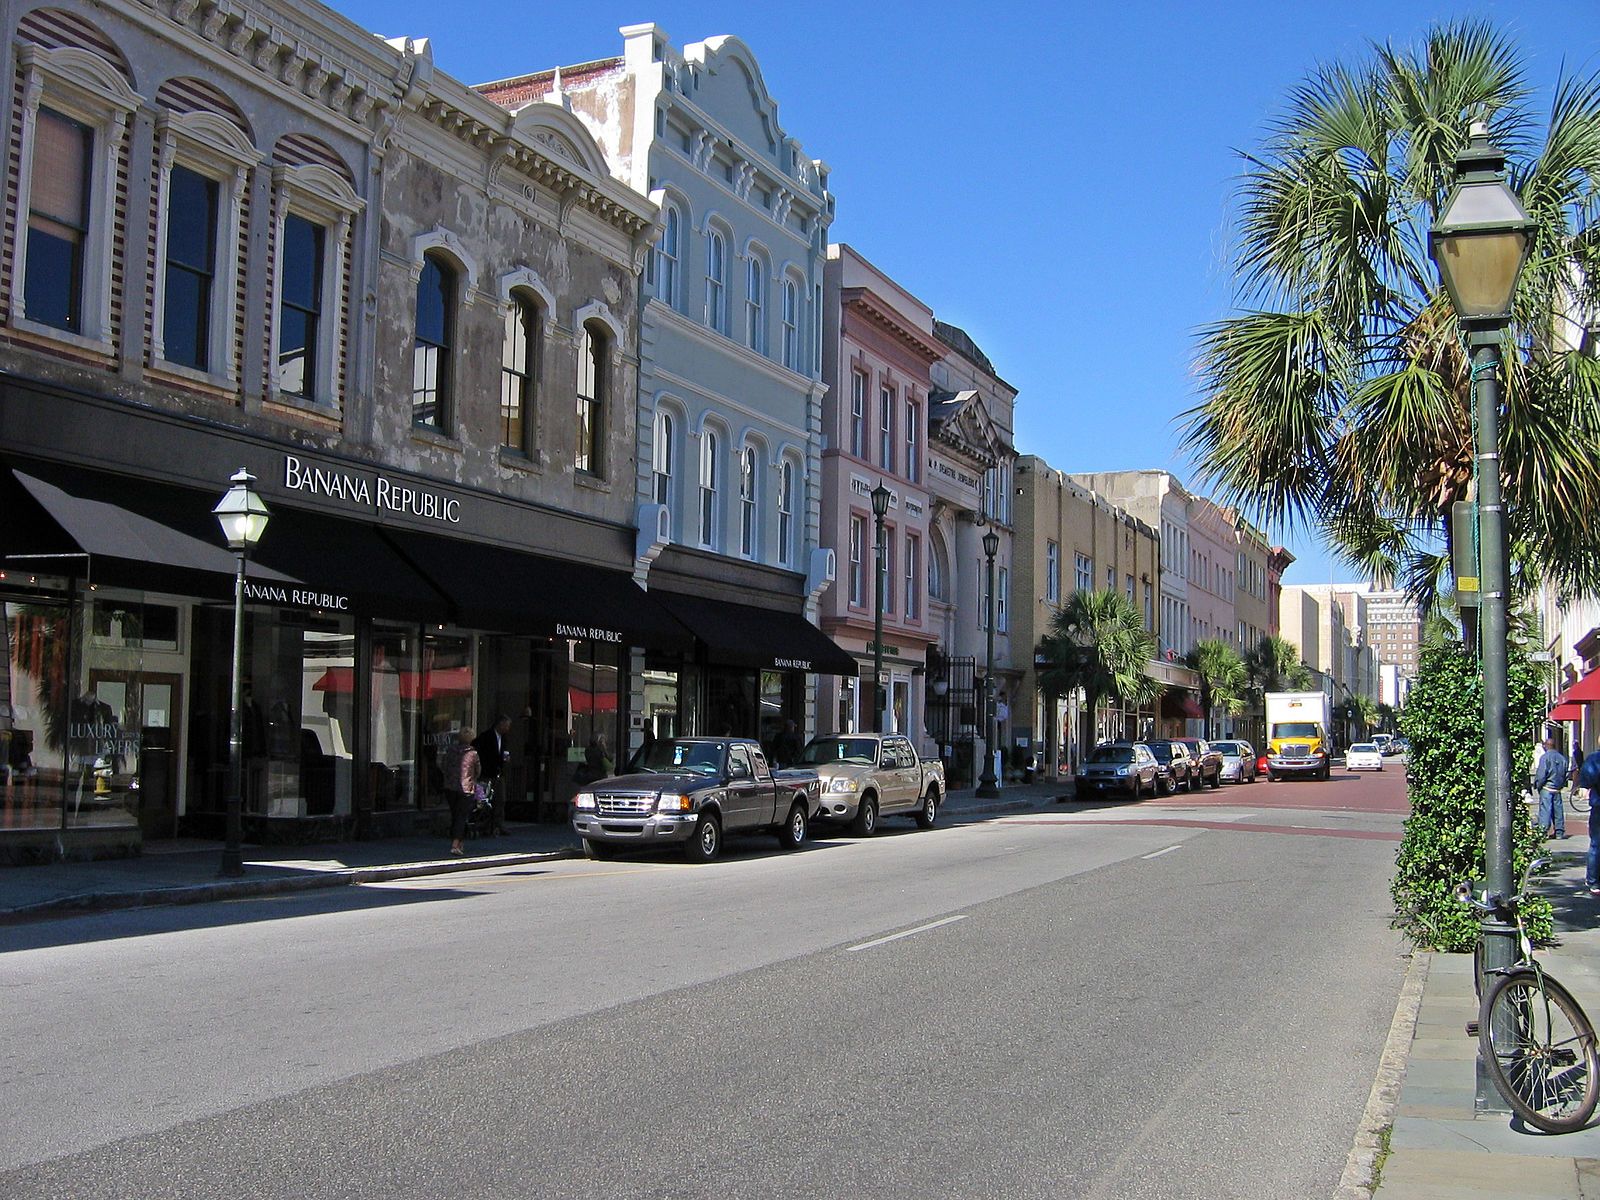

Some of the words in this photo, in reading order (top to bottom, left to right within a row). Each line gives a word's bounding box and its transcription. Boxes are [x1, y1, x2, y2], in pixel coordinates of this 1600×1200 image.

[286, 455, 371, 505] BANANA
[376, 477, 460, 523] REPUBLIC
[292, 589, 348, 610] REPUBLIC
[556, 623, 587, 638] BANANA
[589, 628, 623, 643] REPUBLIC
[70, 723, 118, 739] LUXURY
[95, 740, 140, 755] LAYERS
